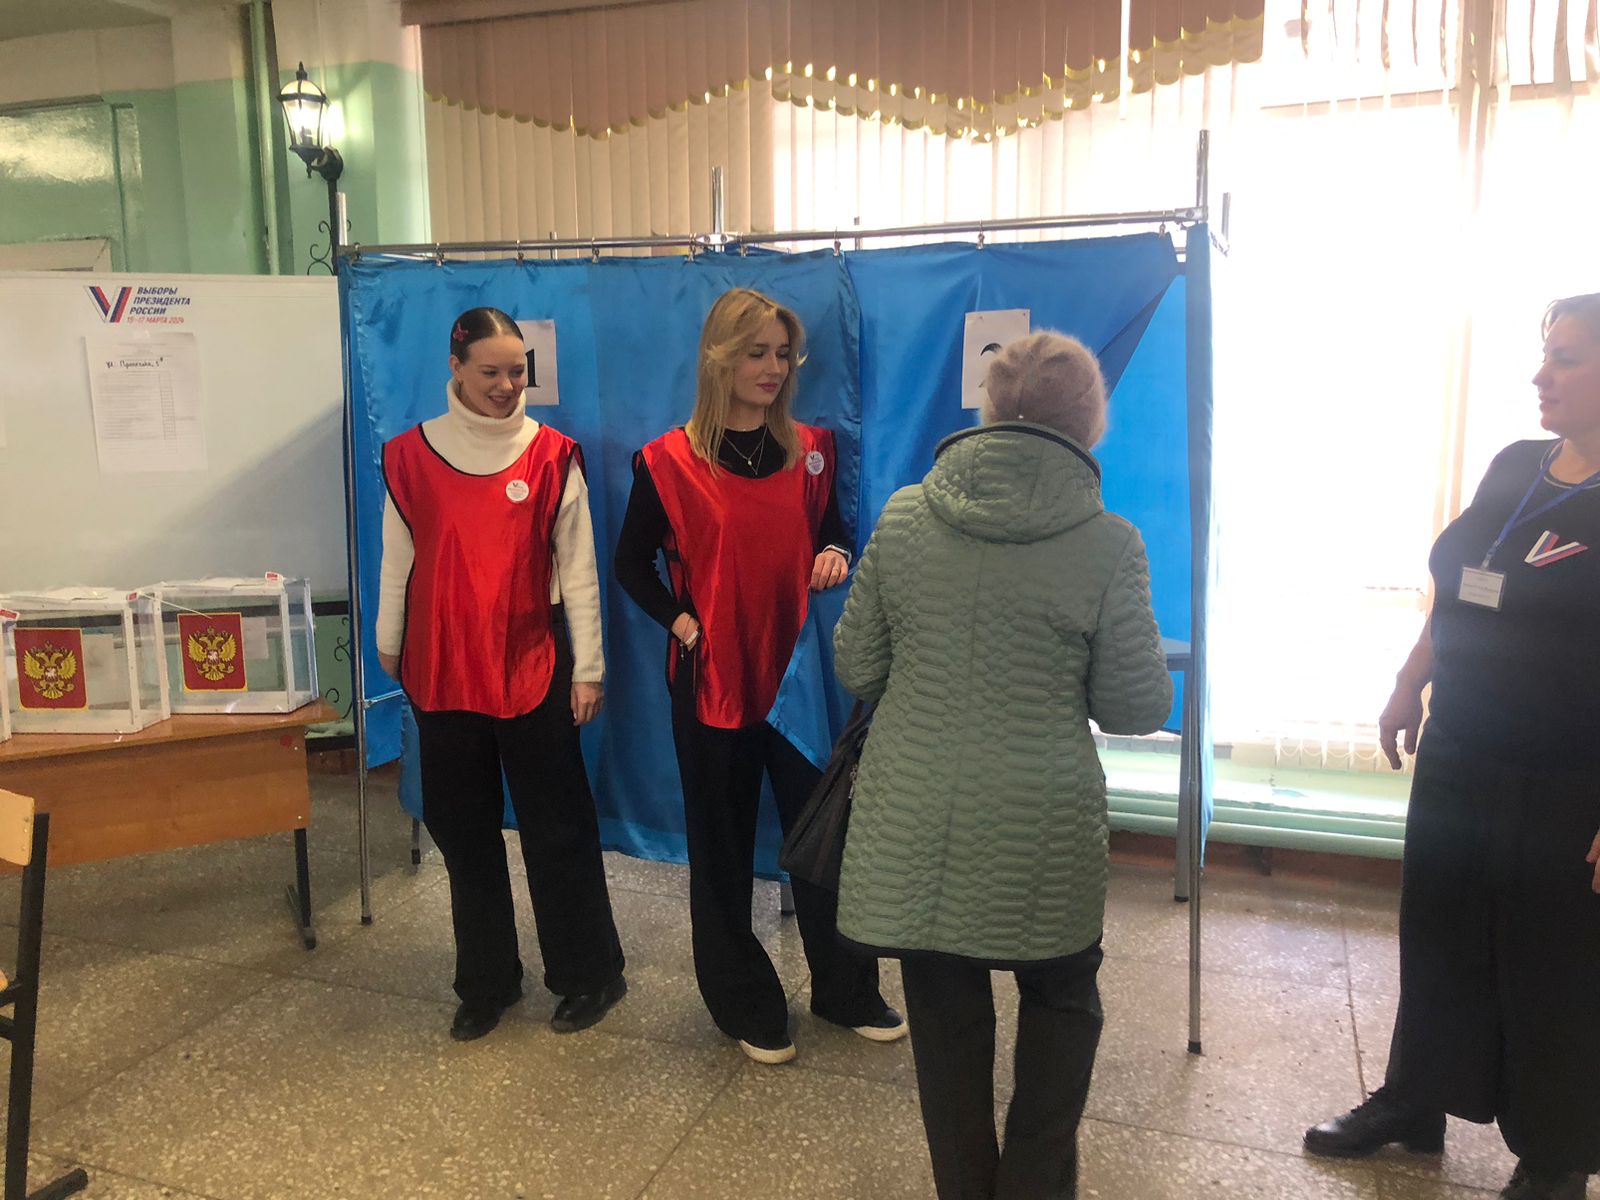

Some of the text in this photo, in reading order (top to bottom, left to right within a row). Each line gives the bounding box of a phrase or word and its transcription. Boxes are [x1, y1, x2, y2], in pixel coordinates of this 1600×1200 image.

[137, 286, 178, 295] ВЫБОРЫ
[133, 297, 191, 306] ПРЕЗИДЕНТА
[129, 307, 167, 315] РОССИИ
[146, 316, 168, 324] МАРТА
[525, 348, 541, 388] 1
